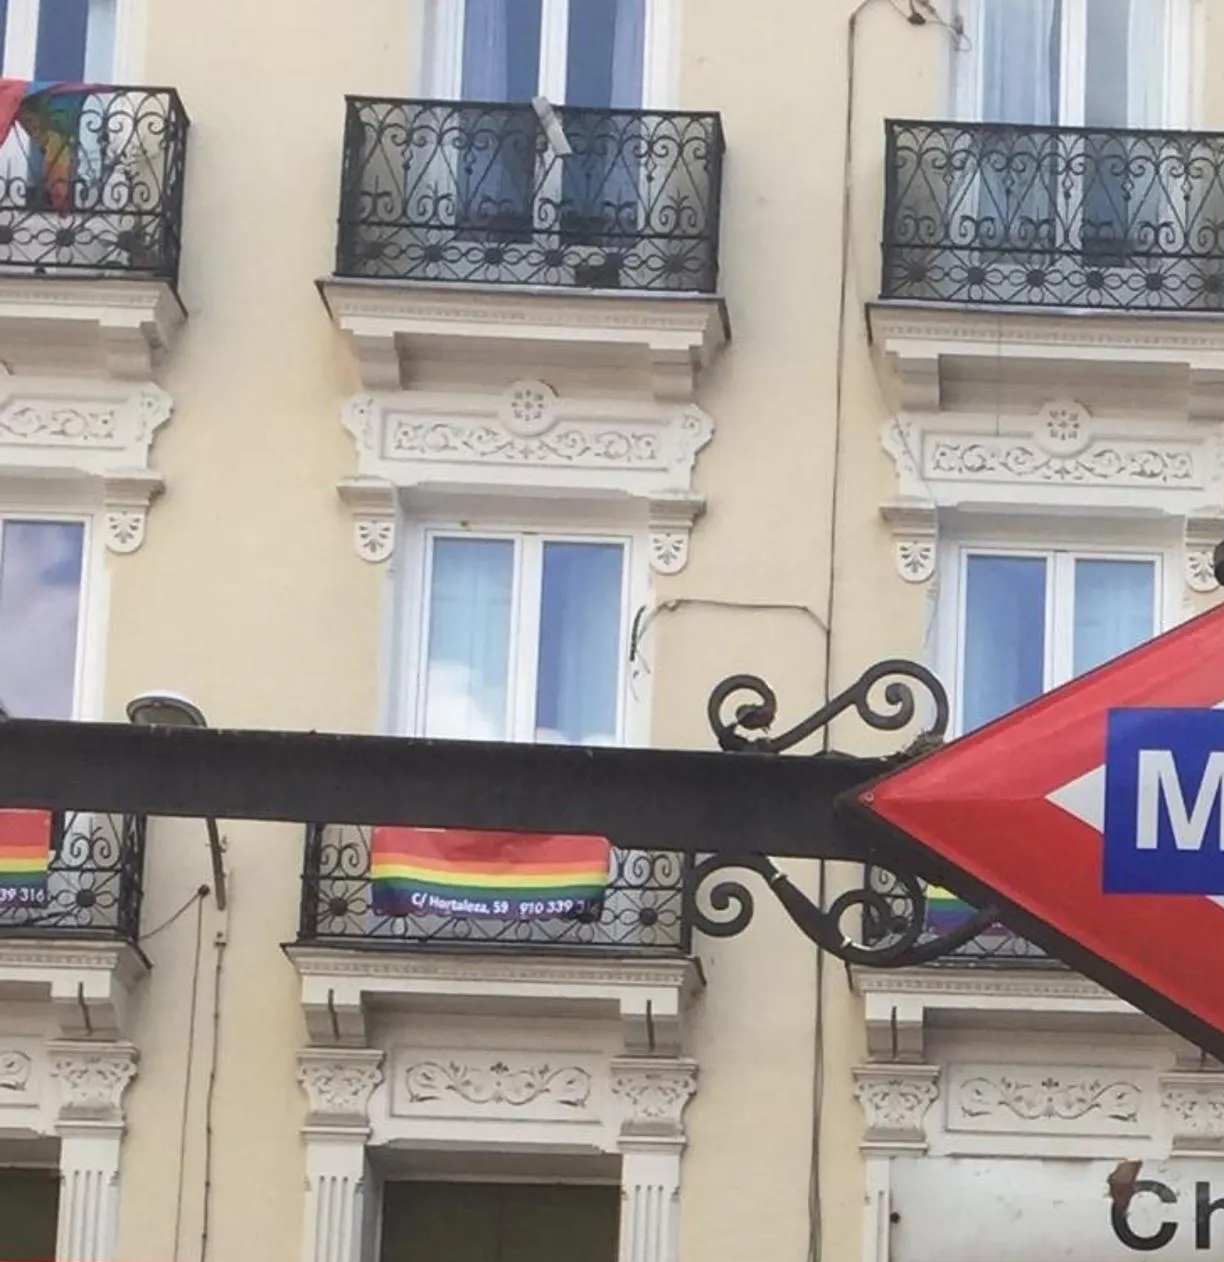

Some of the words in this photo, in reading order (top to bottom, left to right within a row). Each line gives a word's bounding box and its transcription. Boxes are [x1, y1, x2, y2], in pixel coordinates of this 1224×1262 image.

[20, 887, 44, 903] 316
[411, 892, 428, 909] C/
[493, 900, 509, 914] 59
[519, 901, 544, 915] 910
[545, 899, 573, 914] 339
